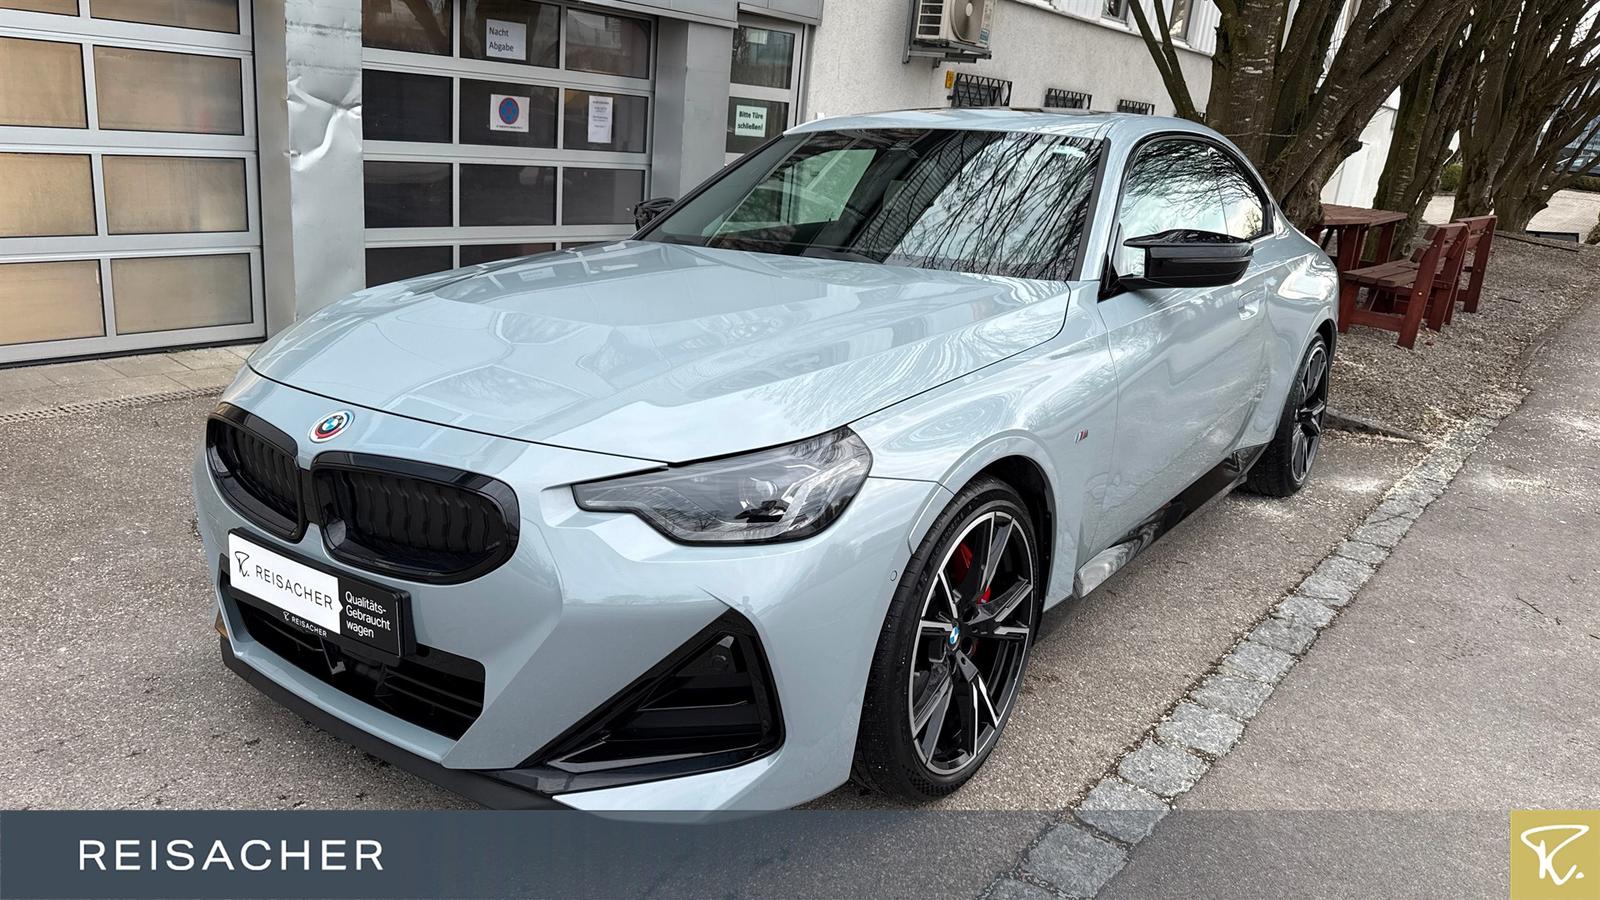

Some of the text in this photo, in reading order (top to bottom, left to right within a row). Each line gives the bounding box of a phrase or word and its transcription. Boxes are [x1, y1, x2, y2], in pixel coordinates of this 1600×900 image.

[489, 26, 509, 37] Nacht
[489, 41, 514, 52] Abgabe
[739, 110, 763, 120] Bitte Türe
[737, 122, 763, 131] schließen!
[256, 565, 333, 610] REISACHER
[345, 591, 387, 615] Qualitäts-
[346, 604, 391, 631] Gebraucht
[291, 616, 328, 638] REISACHER
[346, 620, 374, 638] wagen
